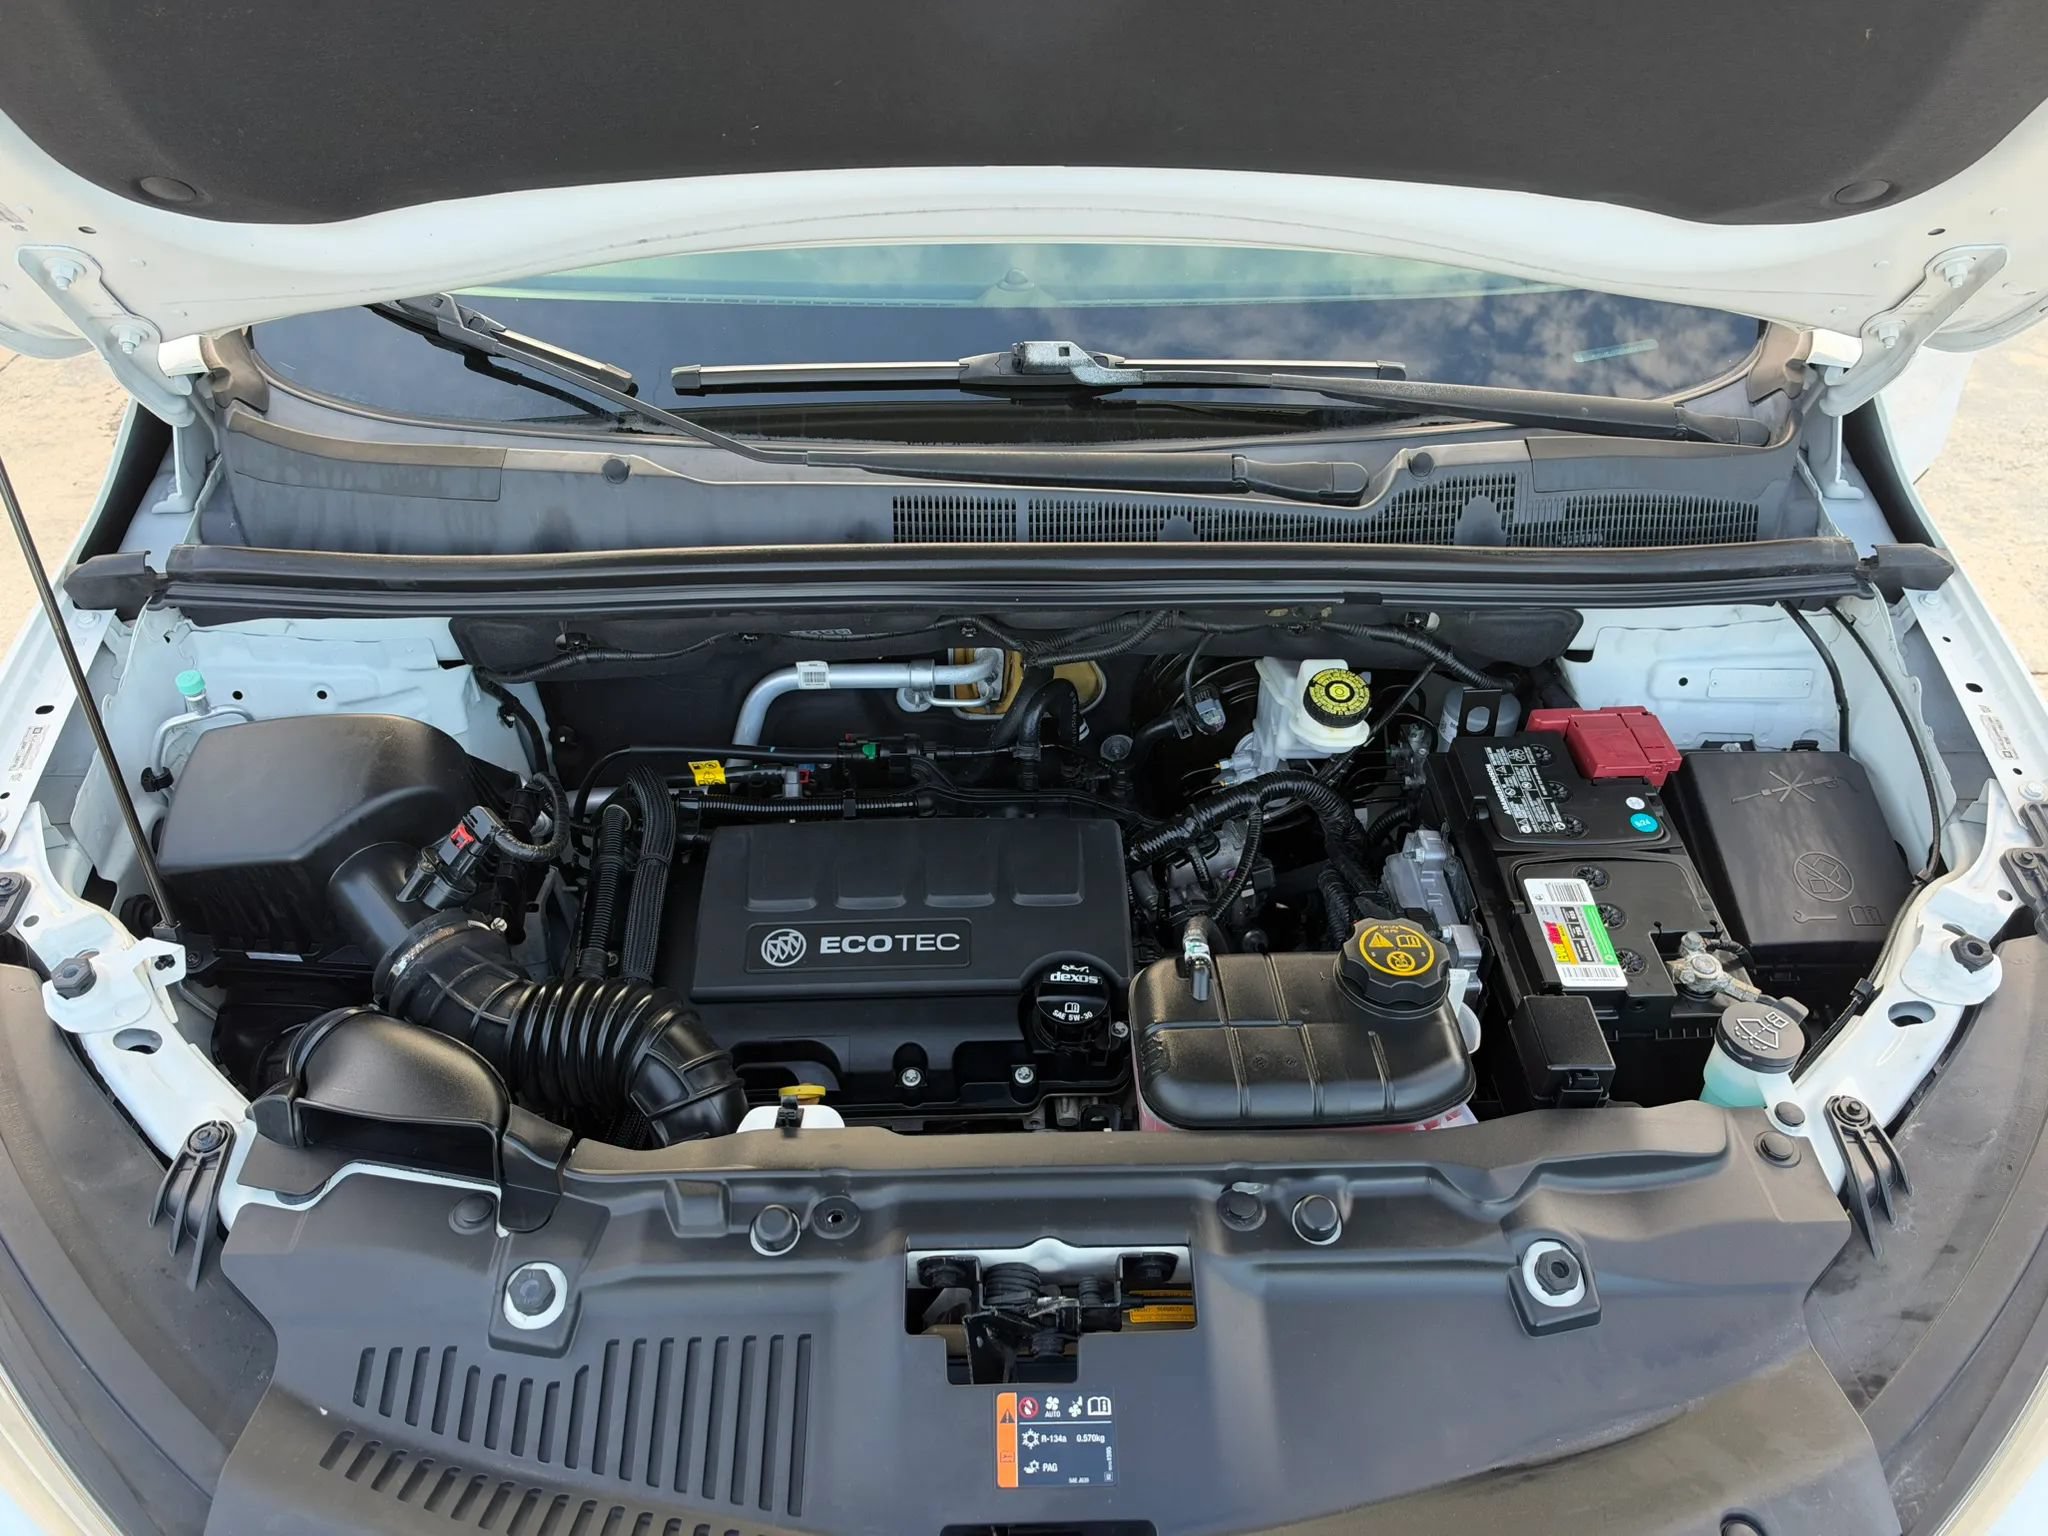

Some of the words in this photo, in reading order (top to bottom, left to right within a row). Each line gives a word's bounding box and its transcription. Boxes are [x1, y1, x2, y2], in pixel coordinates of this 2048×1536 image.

[819, 933, 961, 954] ECOTEC
[1050, 971, 1098, 984] dexos
[1052, 1009, 1067, 1020] SAE
[1068, 1010, 1094, 1022] 5W-30
[1041, 1434, 1067, 1443] R-134a
[1076, 1434, 1106, 1444] 0.570kg
[1042, 1463, 1058, 1472] PAG
